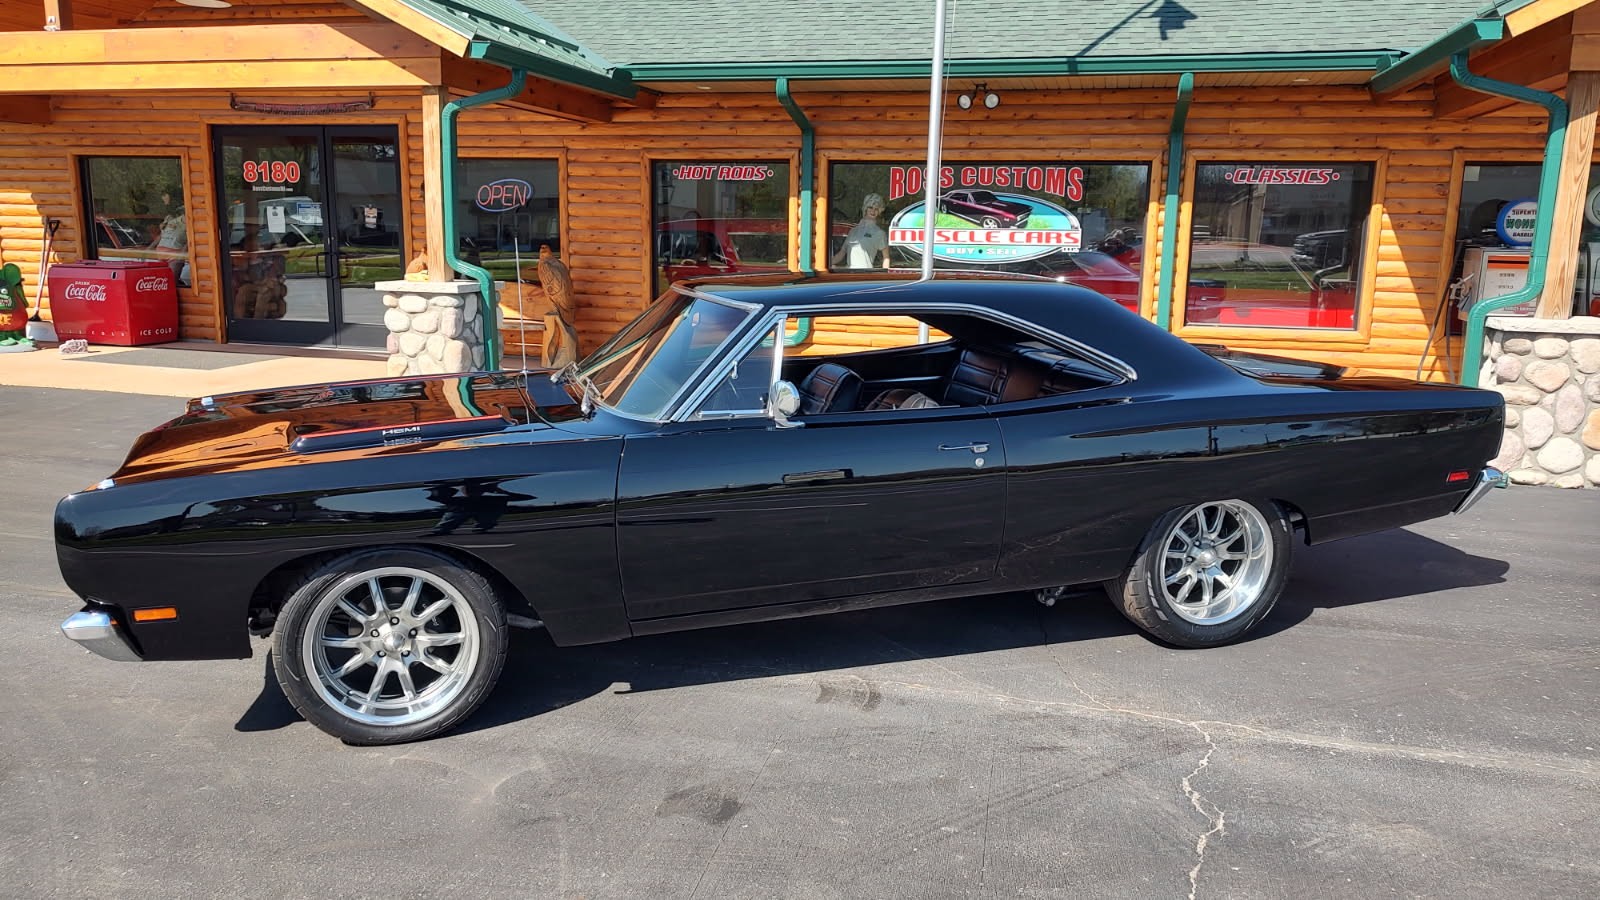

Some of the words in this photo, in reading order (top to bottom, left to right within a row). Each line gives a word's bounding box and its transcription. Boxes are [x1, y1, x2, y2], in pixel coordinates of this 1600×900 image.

[243, 161, 300, 183] 8180
[678, 166, 717, 180] HOT
[718, 166, 768, 180] RODS
[1232, 169, 1333, 184] CLASSICS
[961, 167, 1084, 201] CUSTOMS
[478, 185, 526, 206] OPEN
[1009, 231, 1080, 244] CARS
[945, 247, 975, 255] BUY
[986, 248, 1017, 256] SELL
[155, 327, 172, 335] COLD
[382, 426, 420, 435] HEMI
